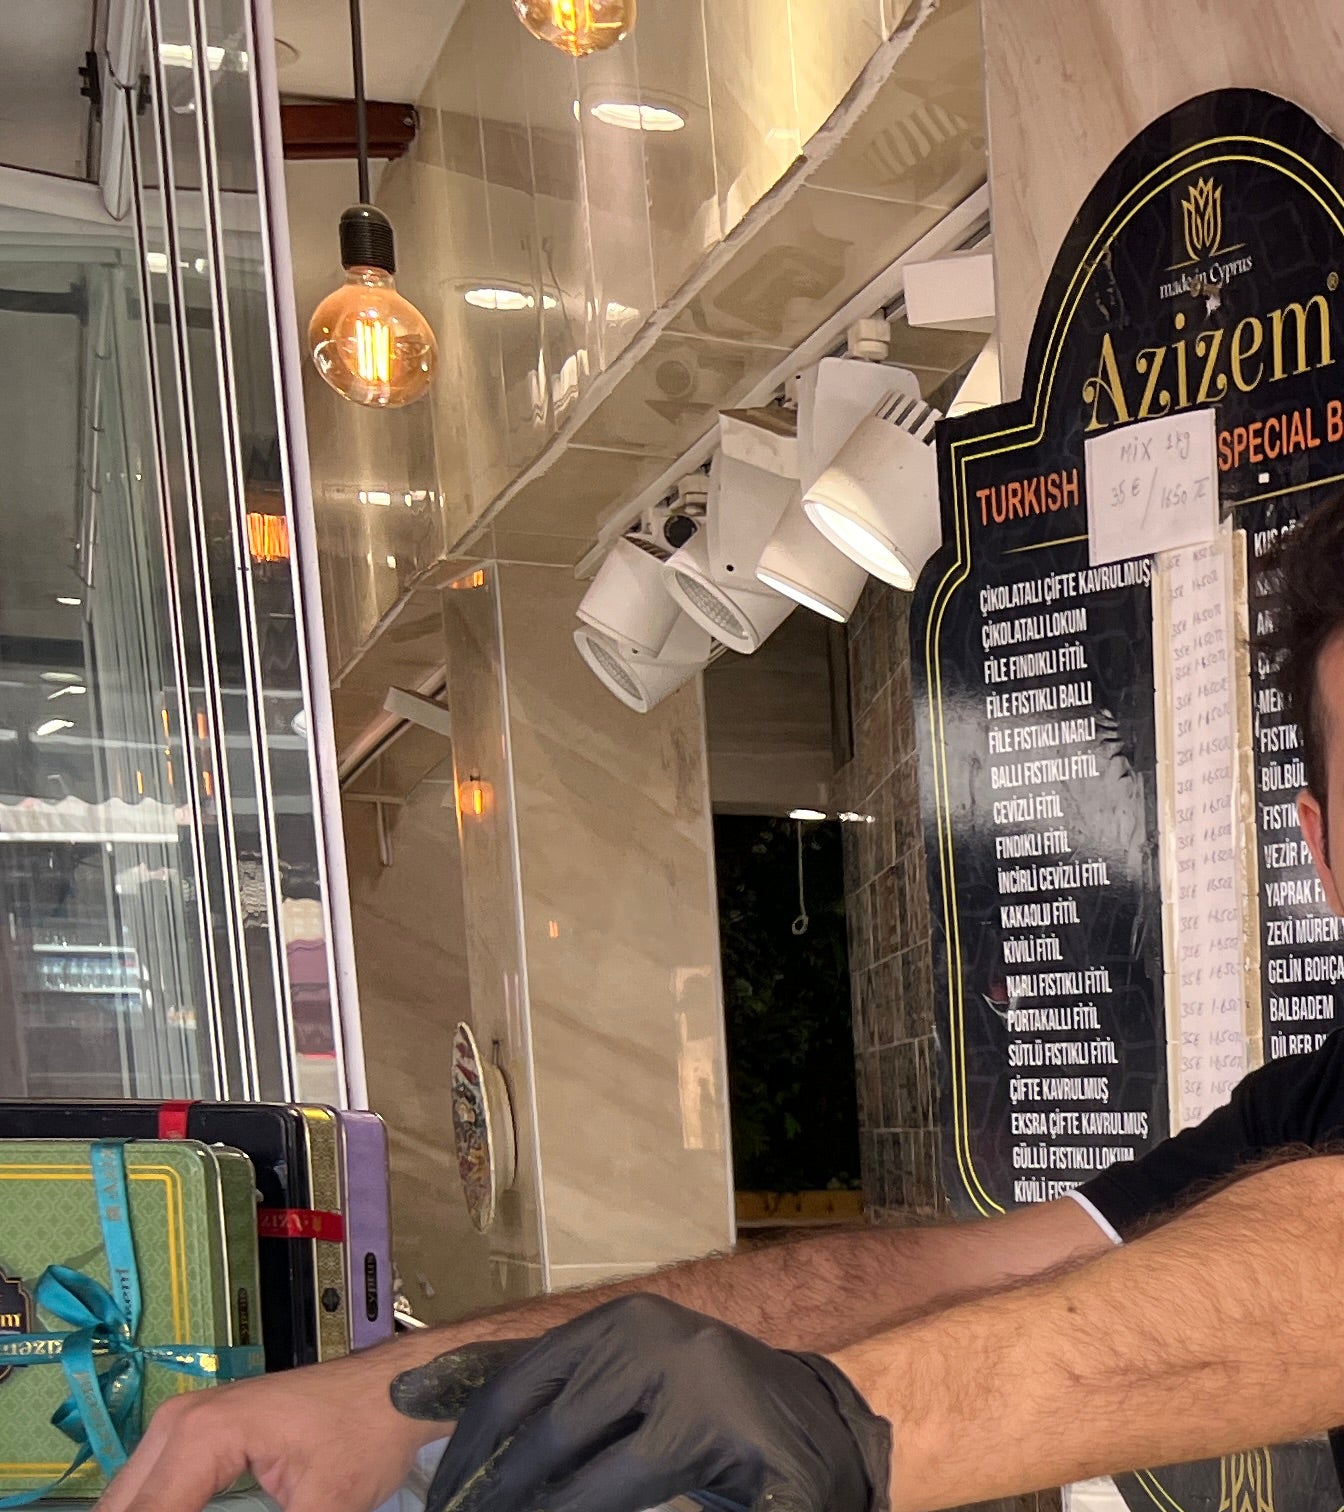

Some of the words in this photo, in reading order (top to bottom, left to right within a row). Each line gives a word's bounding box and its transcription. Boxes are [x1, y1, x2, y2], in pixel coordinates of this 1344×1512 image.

[1210, 255, 1253, 289] Cyprus
[1218, 408, 1321, 471] SPECIAL
[976, 468, 1079, 526] TURKISH
[979, 579, 1043, 617] ÇİKOLATALI
[1043, 572, 1077, 605] ÇİFTE
[1078, 558, 1151, 595] KAVRULMUŞ
[981, 613, 1045, 653] ÇİKOLATALI
[1045, 607, 1088, 638] LOKUM
[984, 656, 1009, 685] FİLE
[1009, 649, 1057, 680] FINDIKLI
[1058, 640, 1088, 672] FİTİL
[986, 691, 1011, 720] FİLE
[1011, 686, 1058, 715] FISTIKLI
[1059, 680, 1092, 709] BALLI
[988, 727, 1013, 755] FİLE
[1014, 722, 1060, 751] FISTIKLI
[1060, 716, 1096, 745] NARLI
[991, 763, 1023, 790] BALLI
[1024, 757, 1070, 786] FISTIKLI
[1071, 750, 1100, 779] FİTİL
[1262, 758, 1308, 792] BÜLBÜL
[993, 793, 1035, 825] CEVİZLİ
[1036, 790, 1064, 819] FİTİL
[995, 833, 1042, 860] FINDIKLI
[1043, 826, 1072, 855] FİTİL
[1264, 838, 1299, 869] VEZİR
[997, 864, 1038, 894] İNCİRLİ
[1039, 859, 1081, 891] CEVİZLİ
[1081, 857, 1111, 887] FİTİL
[1265, 879, 1313, 907] YAPRAK
[1000, 902, 1051, 929] KAKAOLU
[1052, 896, 1080, 925] FİTİL
[1267, 916, 1293, 946] ZEKİ
[1296, 914, 1339, 943] MÜREN
[1003, 935, 1035, 964] KİVİLİ
[1036, 932, 1063, 962] FİTİL
[1006, 974, 1037, 998] NARLI
[1039, 971, 1083, 997] FISTIKLI
[1084, 965, 1113, 994] FİTİL
[1268, 954, 1301, 984] GELİN
[1007, 1007, 1071, 1032] PORTAKALLI
[1073, 1002, 1101, 1030] FİTİL
[1270, 995, 1334, 1021] BALBADEM
[1008, 1039, 1043, 1067] SÜTLÜ
[1045, 1041, 1088, 1066] FISTIKLI
[1090, 1036, 1119, 1064] FİTİL
[1010, 1074, 1041, 1105] ÇİFTE
[1042, 1077, 1109, 1104] KAVRULMUŞ
[1011, 1112, 1047, 1135] EKSRA
[1049, 1108, 1080, 1139] ÇİFTE
[1081, 1112, 1148, 1139] KAVRULMUŞ
[1012, 1142, 1048, 1169] GÜLLÜ
[1050, 1147, 1093, 1169] FISTIKLI
[1013, 1176, 1046, 1203] KİVİLİ
